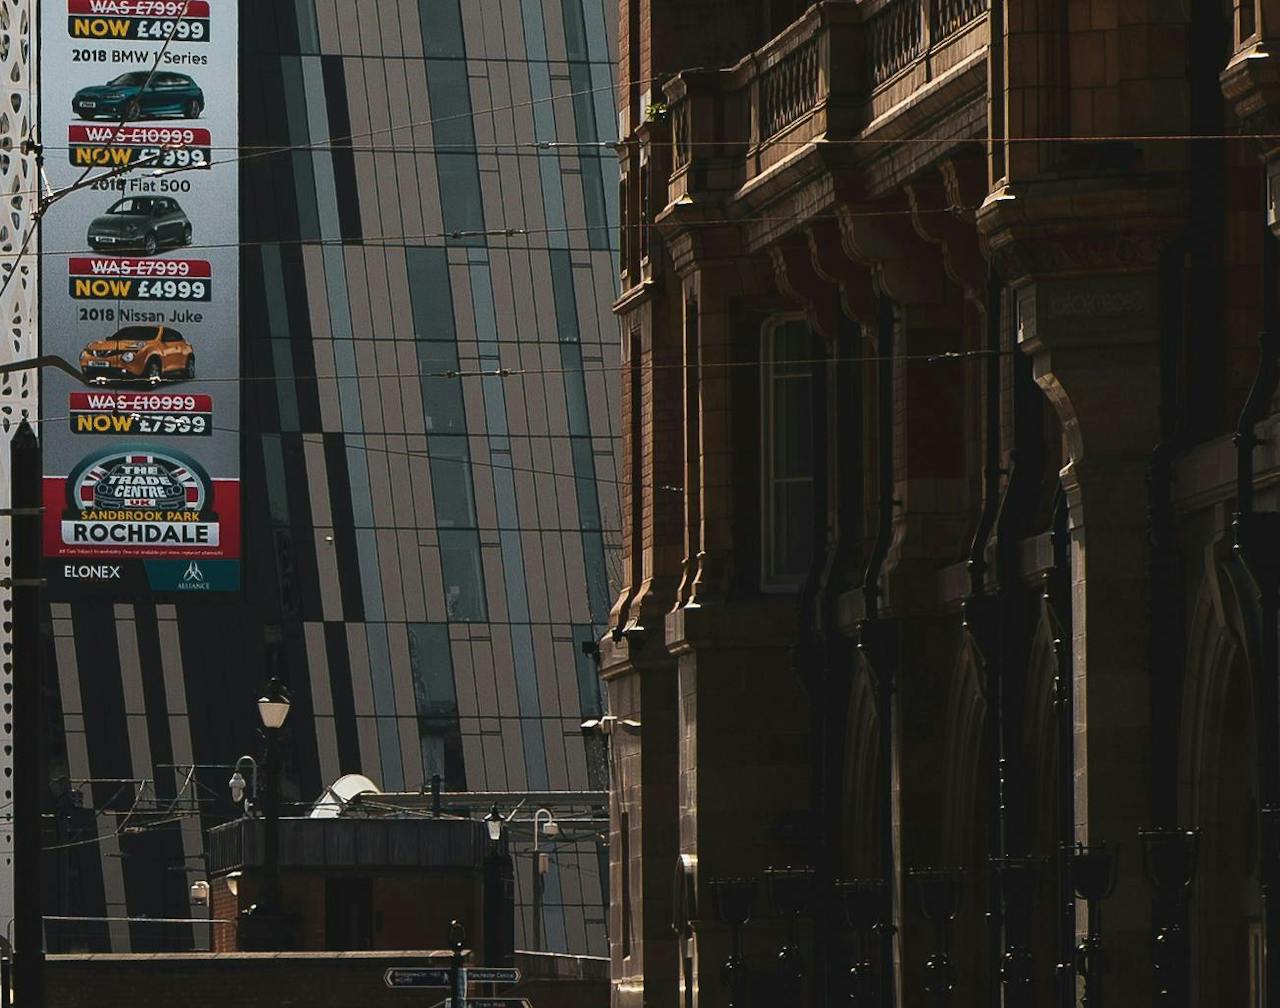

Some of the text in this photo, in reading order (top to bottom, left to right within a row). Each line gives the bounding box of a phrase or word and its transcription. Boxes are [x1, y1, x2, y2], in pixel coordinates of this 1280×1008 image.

[90, 0, 188, 16] WAS £7999
[74, 19, 204, 39] NOW £4999
[72, 49, 107, 62] 2018
[112, 51, 149, 63] BMW
[163, 51, 208, 65] Series
[85, 127, 194, 143] WAS £10999
[76, 146, 133, 165] NOW
[130, 179, 155, 192] Fiat
[160, 180, 191, 192] 500
[90, 260, 189, 276] WAS £7999
[75, 279, 205, 299] NOW £4999
[79, 308, 203, 323] 2018 Nissan Juke
[87, 394, 195, 410] WAS £10999
[77, 414, 206, 433] NOW £7999
[122, 466, 158, 475] THE
[108, 475, 172, 486] TRADE
[114, 485, 168, 498] CENTRE
[81, 510, 200, 521] SANDBROOK PARK
[74, 523, 209, 544] ROCHDALE
[64, 564, 121, 579] ELONEX
